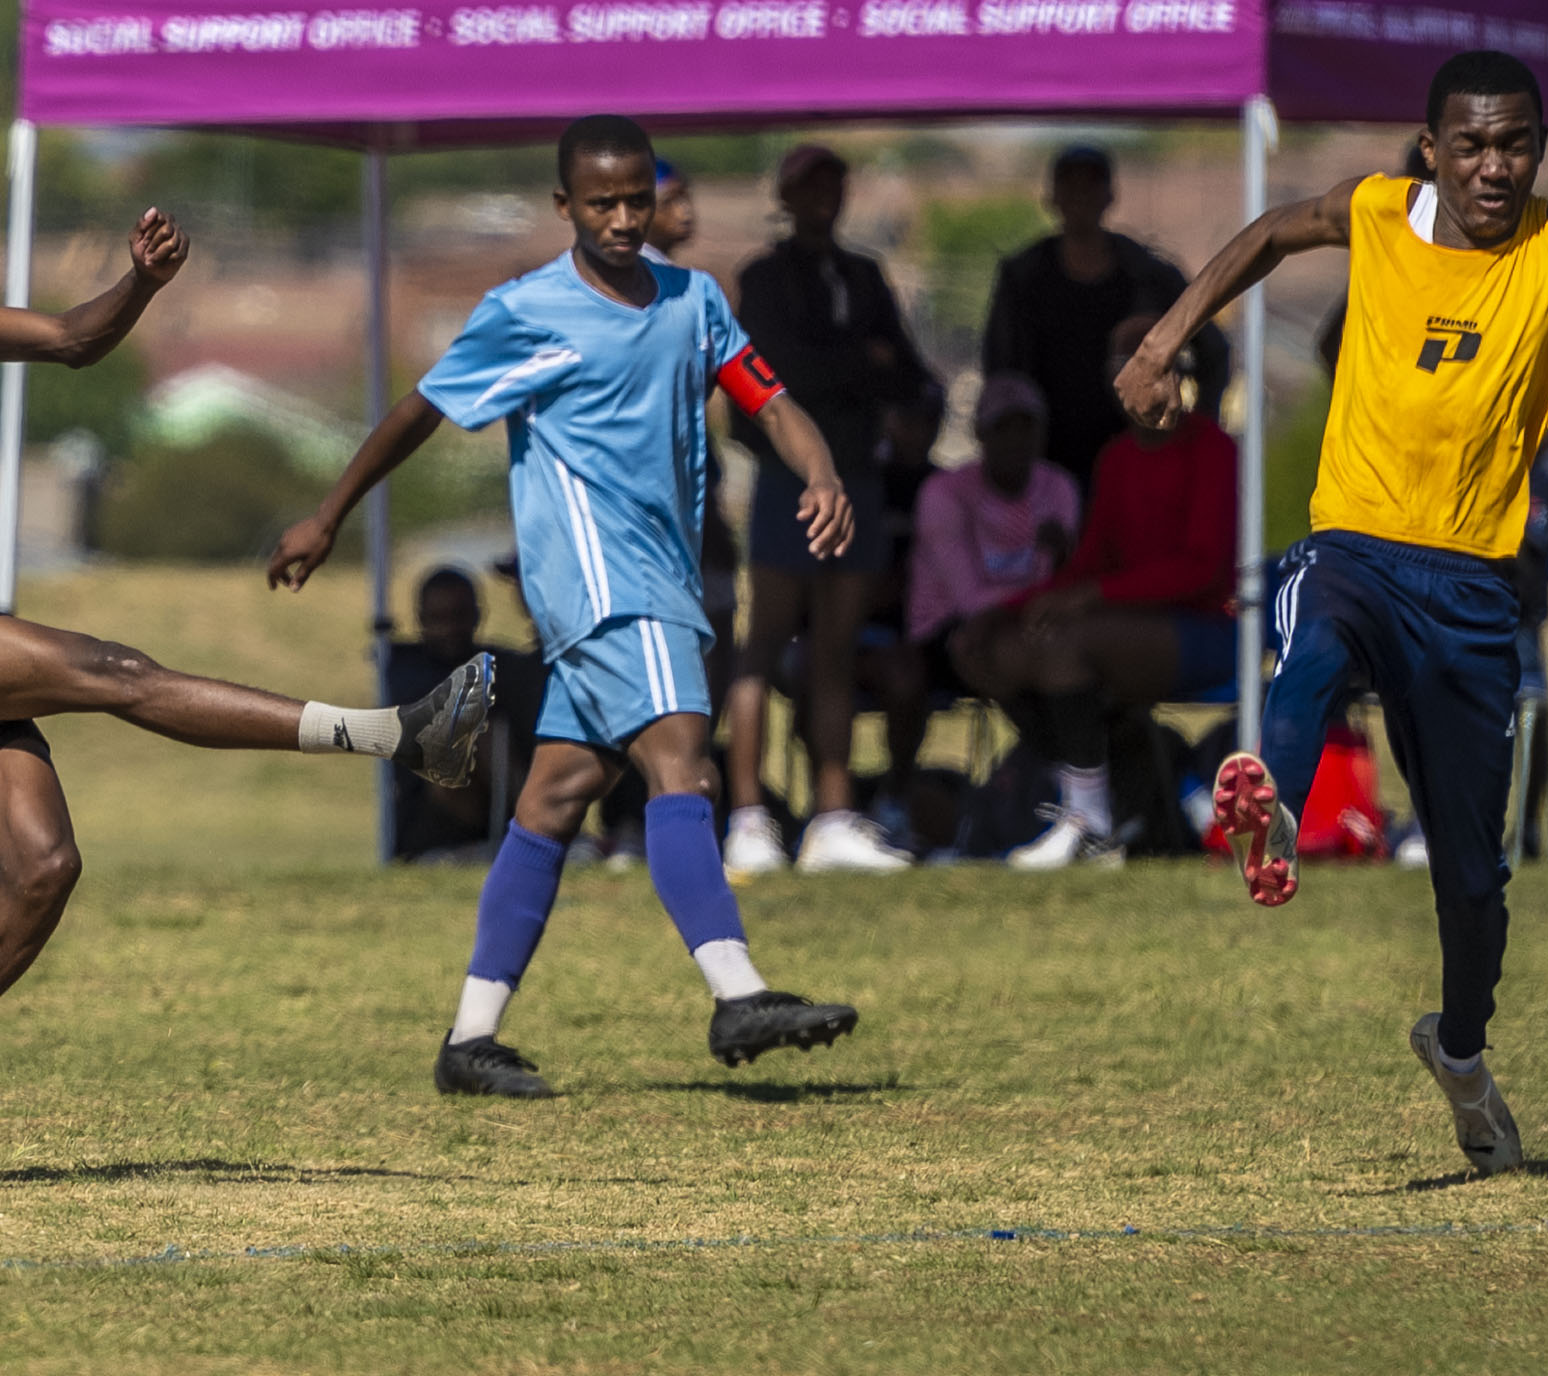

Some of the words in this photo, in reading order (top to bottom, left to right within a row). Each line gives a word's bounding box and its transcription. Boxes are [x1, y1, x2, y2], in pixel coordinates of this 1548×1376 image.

[160, 13, 306, 52] SUPPORT
[308, 9, 421, 50] OFFICE
[449, 5, 561, 45] SOCIAL
[566, 1, 712, 42] SUPPORT
[714, 0, 828, 40] OFFICE
